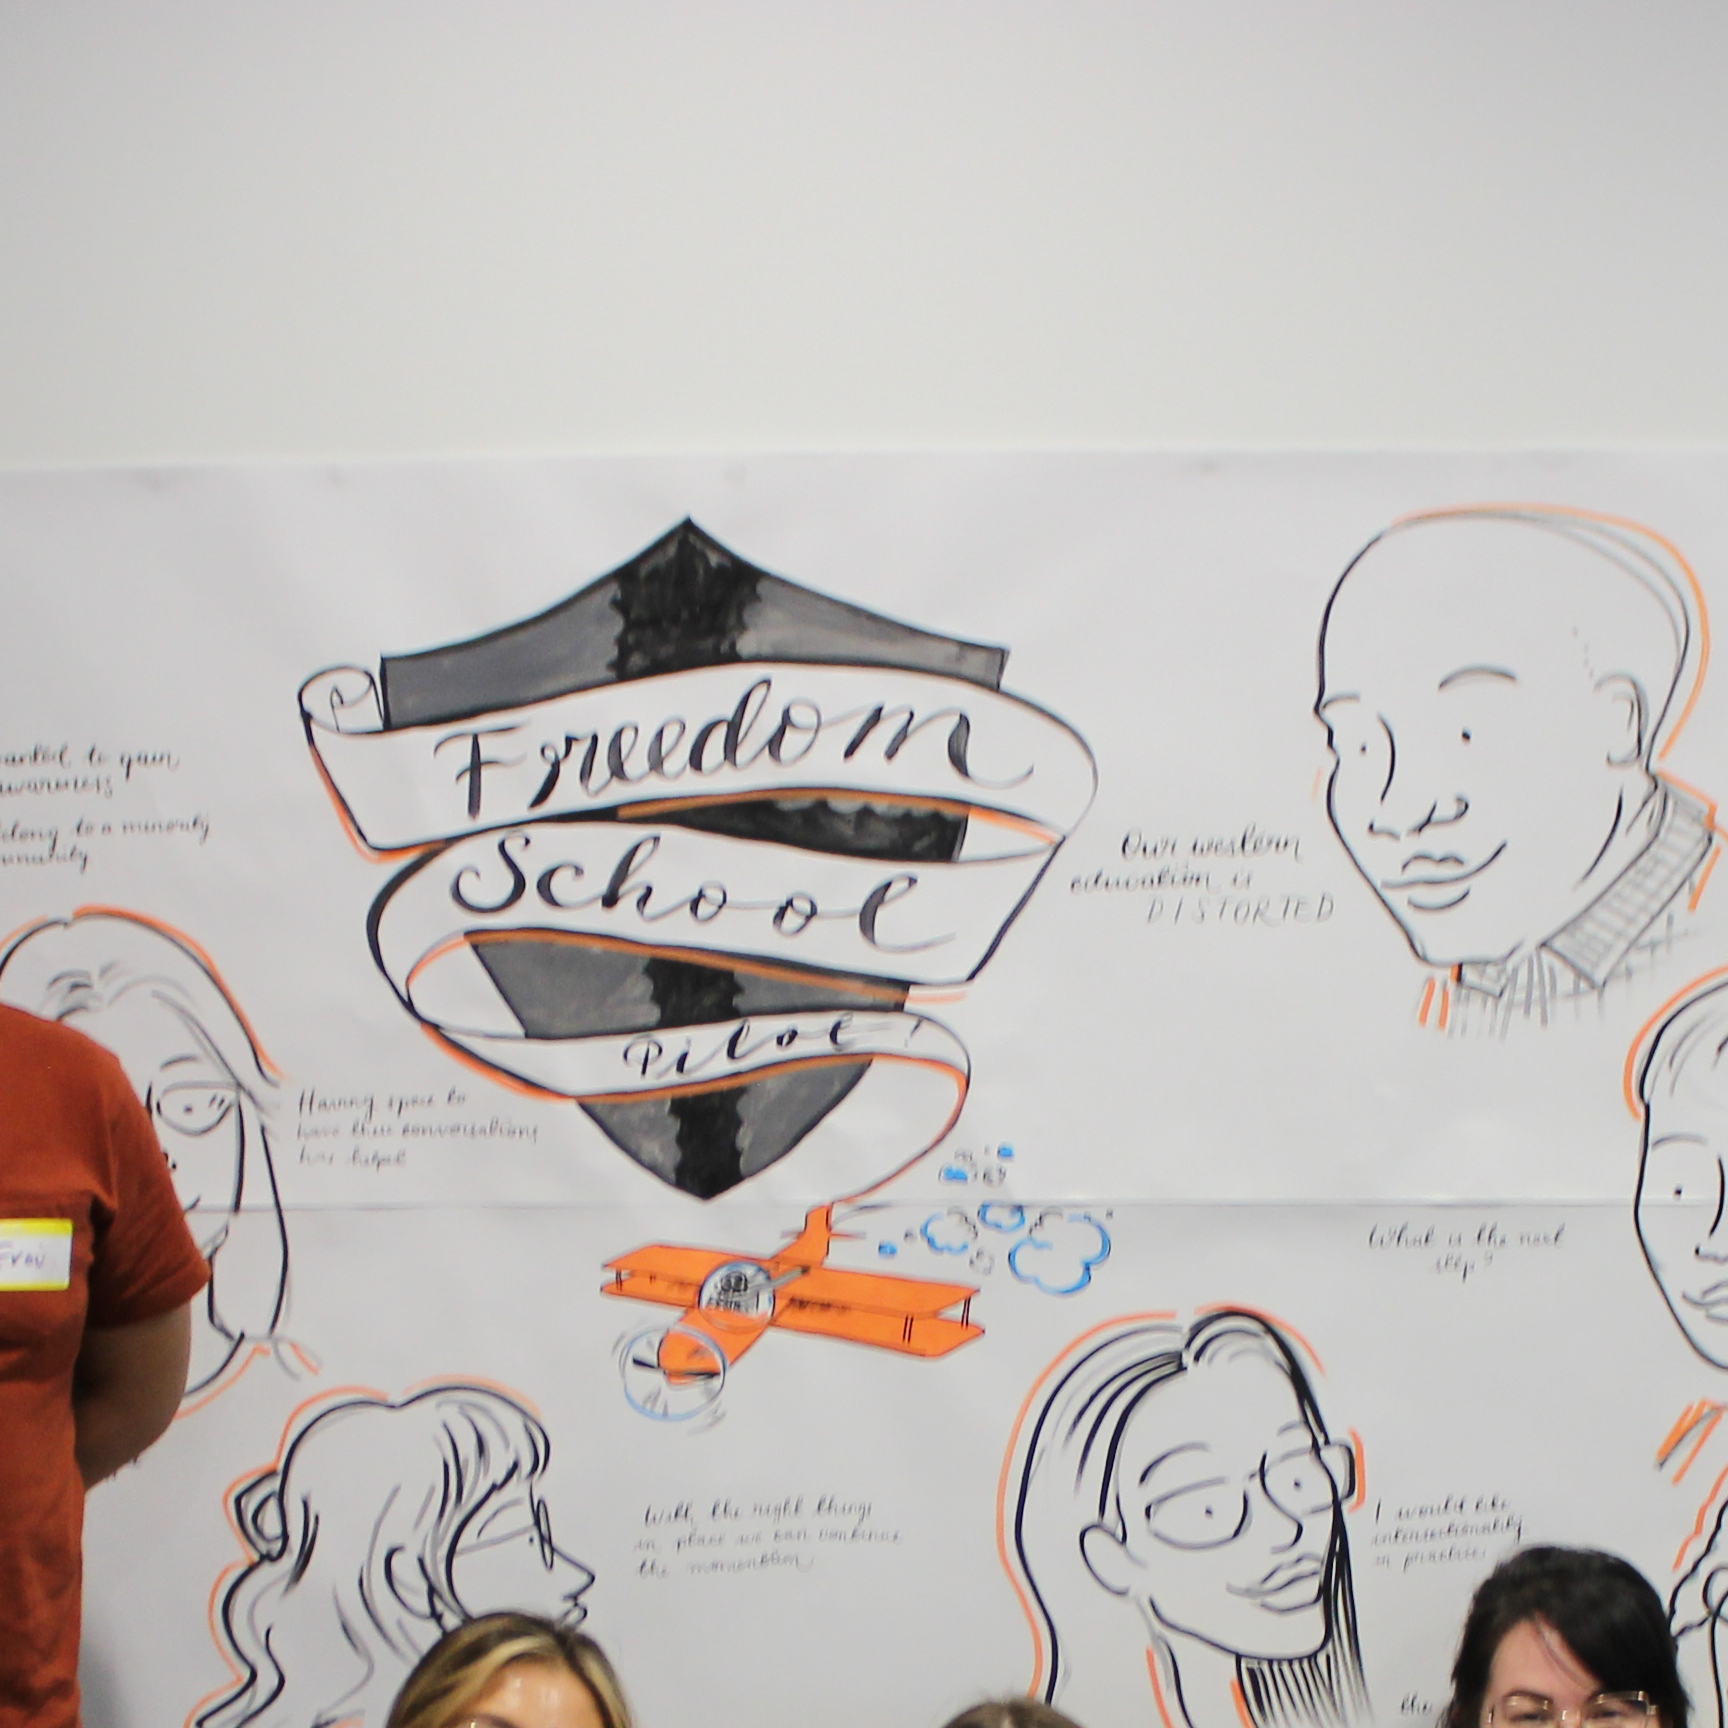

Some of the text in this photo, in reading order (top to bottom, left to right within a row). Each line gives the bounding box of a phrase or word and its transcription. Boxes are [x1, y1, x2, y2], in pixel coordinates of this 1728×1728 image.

[434, 678, 1035, 820] Freedom
[122, 812, 210, 846] minority
[1122, 820, 1304, 865] Our western
[450, 830, 957, 953] School
[1070, 859, 1222, 894] education
[1147, 891, 1335, 927] DISTORTED
